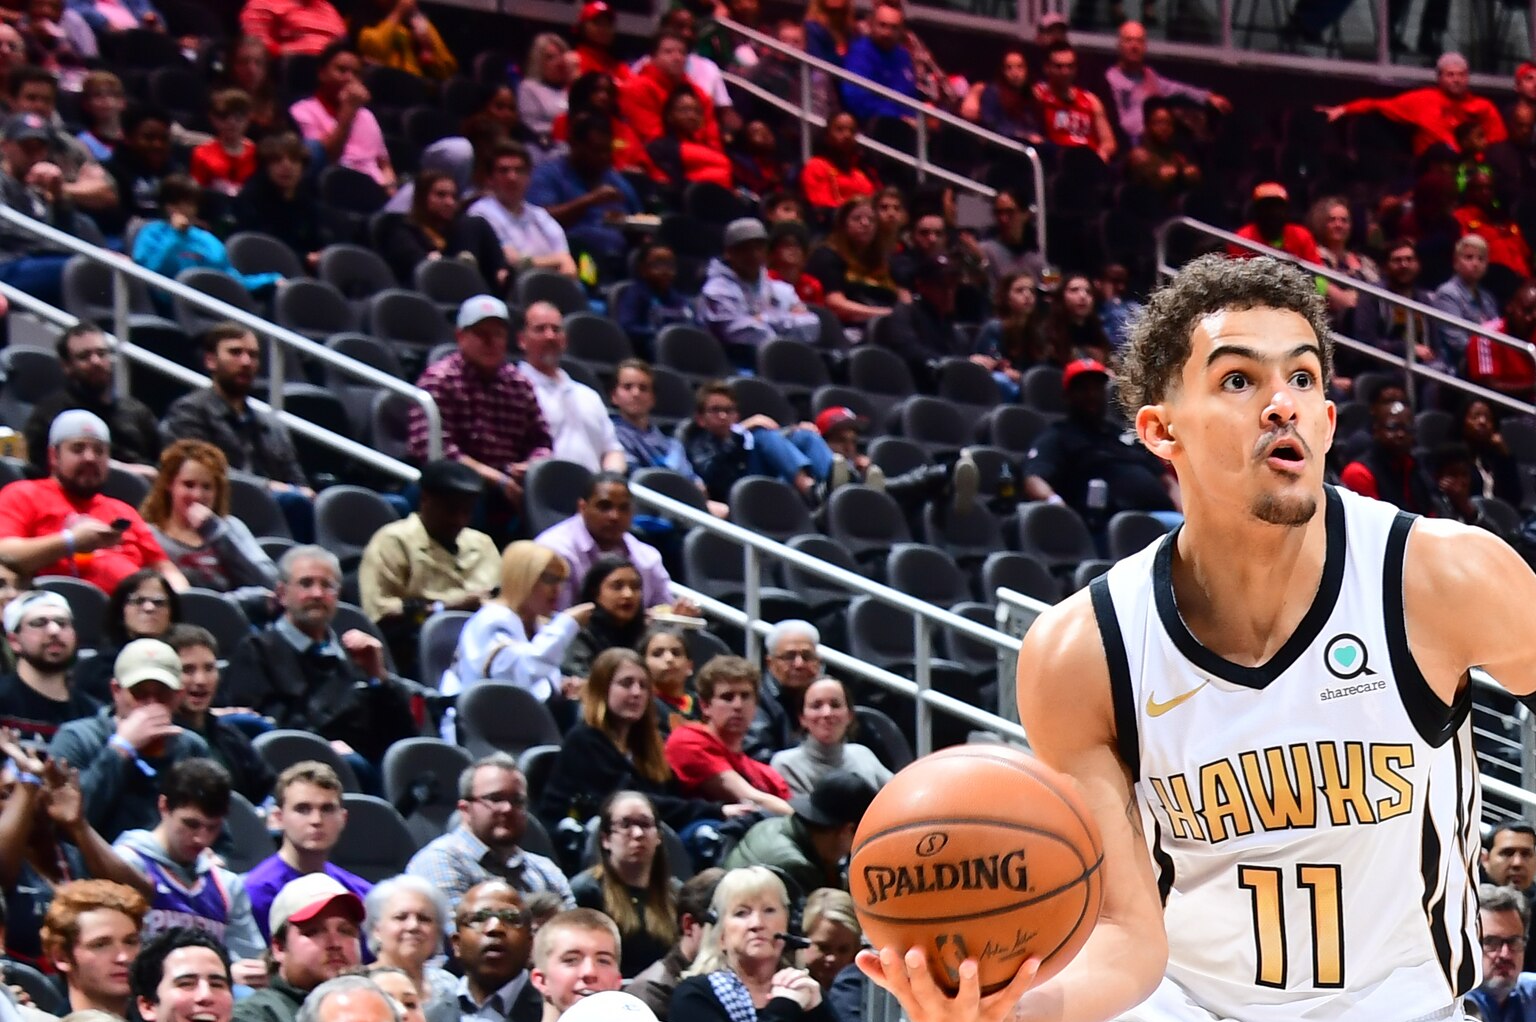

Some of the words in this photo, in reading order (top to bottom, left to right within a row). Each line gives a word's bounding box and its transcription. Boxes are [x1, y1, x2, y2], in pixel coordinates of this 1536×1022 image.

[1319, 680, 1387, 701] sharecare
[1149, 741, 1415, 844] HAWKS
[863, 849, 1029, 906] SPALDING
[1238, 864, 1344, 989] 11
